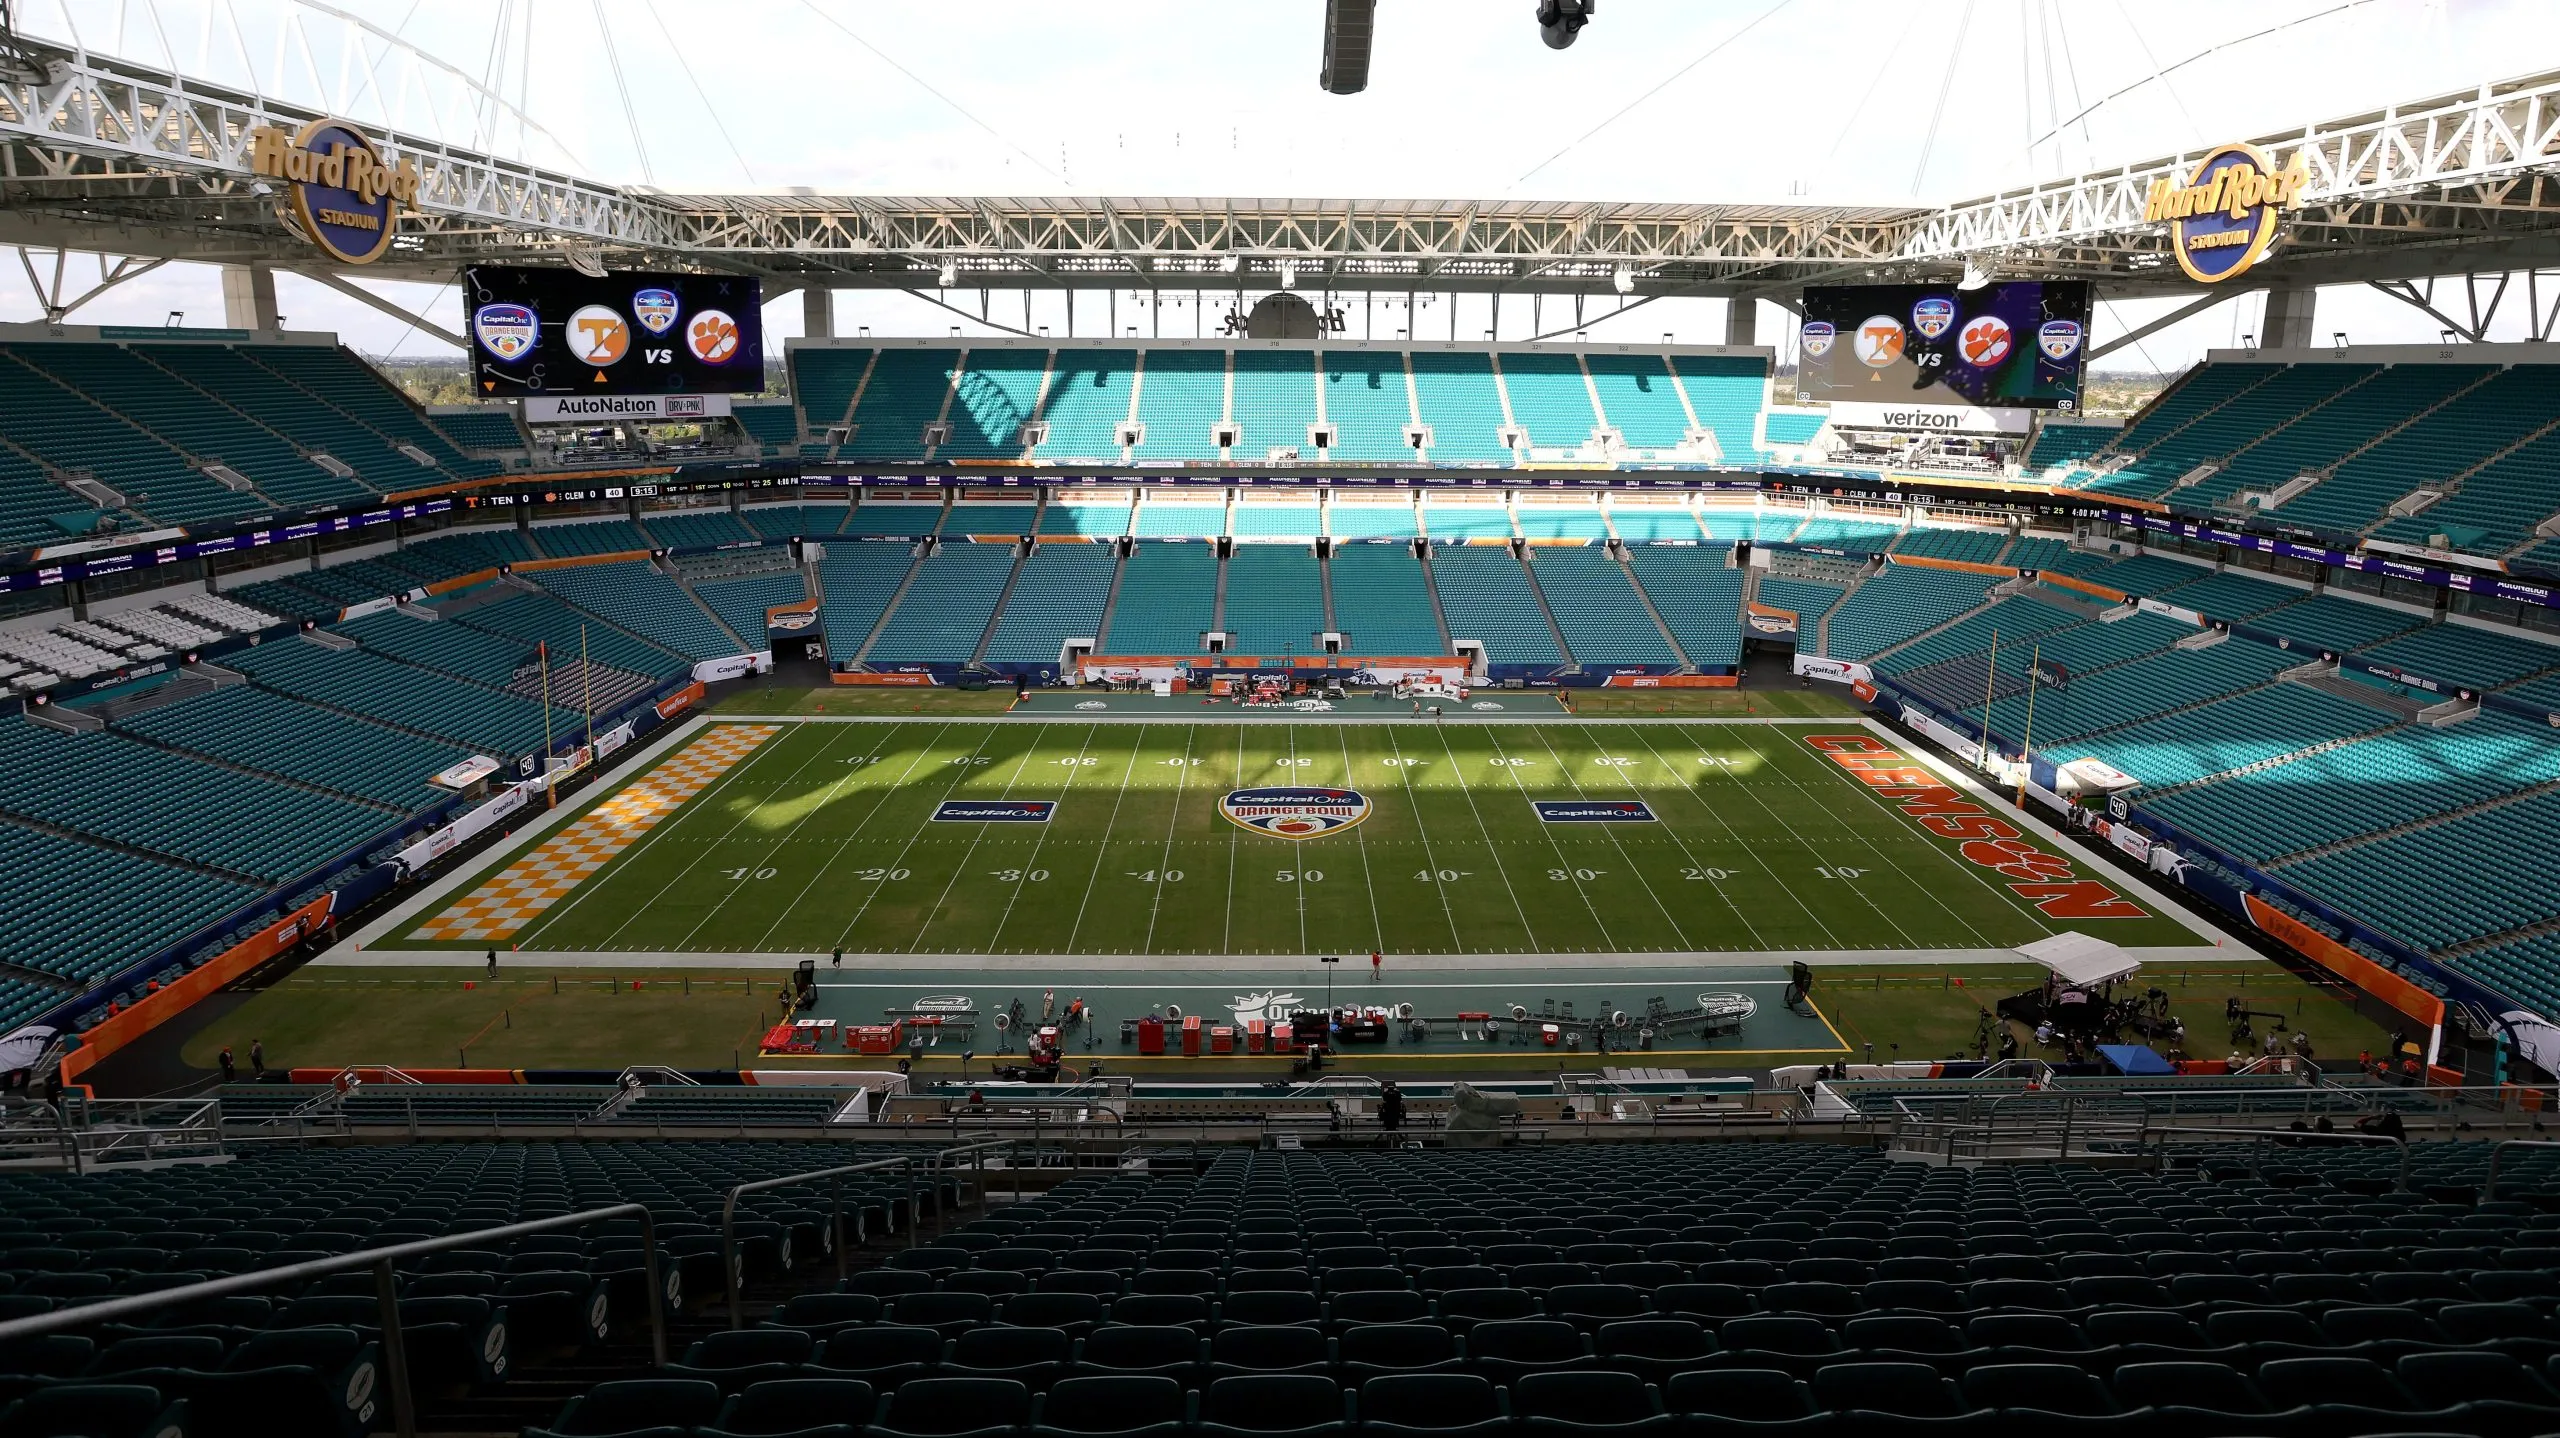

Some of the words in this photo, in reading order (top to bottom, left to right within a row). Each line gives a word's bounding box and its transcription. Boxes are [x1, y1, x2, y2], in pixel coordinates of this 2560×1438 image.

[253, 126, 346, 189] Hard
[344, 147, 423, 212] Rock
[2143, 166, 2229, 222] Hard
[2219, 155, 2308, 220] Rock
[319, 208, 380, 231] STADIUM
[2188, 229, 2250, 250] STADIUM
[577, 318, 621, 358] T
[1864, 326, 1904, 361] T
[644, 348, 673, 364] VS
[1917, 352, 1943, 367] VS
[2439, 351, 2454, 359] 330
[556, 397, 657, 415] AutoNation
[685, 401, 702, 413] PNK
[2058, 400, 2073, 410] CC
[1883, 409, 1960, 429] verizon
[490, 496, 514, 506] TEN
[522, 494, 529, 503] 0
[564, 491, 584, 500] CLEM
[589, 489, 596, 498] 0
[609, 489, 620, 497] 40
[635, 486, 654, 496] 9:15
[1791, 486, 1809, 494] TEN
[1815, 487, 1821, 495] 0
[1849, 490, 1867, 499] CLEM
[1871, 491, 1877, 499] 0
[1913, 496, 1931, 504] 9:15
[2053, 506, 2065, 515] 25
[2089, 508, 2100, 518] PM
[1803, 663, 1853, 680] CapitalOne
[1633, 679, 1659, 687] ESPN
[521, 757, 534, 772] 40
[845, 756, 882, 765] 10
[949, 756, 992, 766] 20
[1060, 757, 1100, 767] 30
[1167, 757, 1206, 767] 40
[1275, 758, 1313, 767] 50
[1382, 758, 1423, 767] 40
[1488, 757, 1530, 767] 30
[1593, 756, 1634, 766] 20
[1697, 756, 1734, 766] 10
[1234, 794, 1353, 804] CapitalOne
[942, 807, 1047, 818] CapitalOne
[1235, 806, 1303, 817] ORANGE
[1305, 806, 1355, 817] BOWL
[1544, 807, 1647, 818] CapitalOne
[2112, 797, 2125, 817] 40
[1801, 734, 2154, 919] CLEMSN
[727, 867, 778, 880] 10
[858, 868, 912, 882] 20
[999, 868, 1051, 882] 30
[1135, 869, 1186, 882] 40
[1275, 869, 1324, 882] 50
[1412, 868, 1459, 882] 40
[1546, 868, 1597, 881] 30
[1679, 866, 1731, 880] 20
[1813, 865, 1860, 880] 10
[278, 922, 299, 944] ESP
[1044, 1036, 1051, 1044] G
[1546, 1033, 1553, 1041] G
[494, 1359, 505, 1372] 20
[361, 1404, 373, 1420] 21
